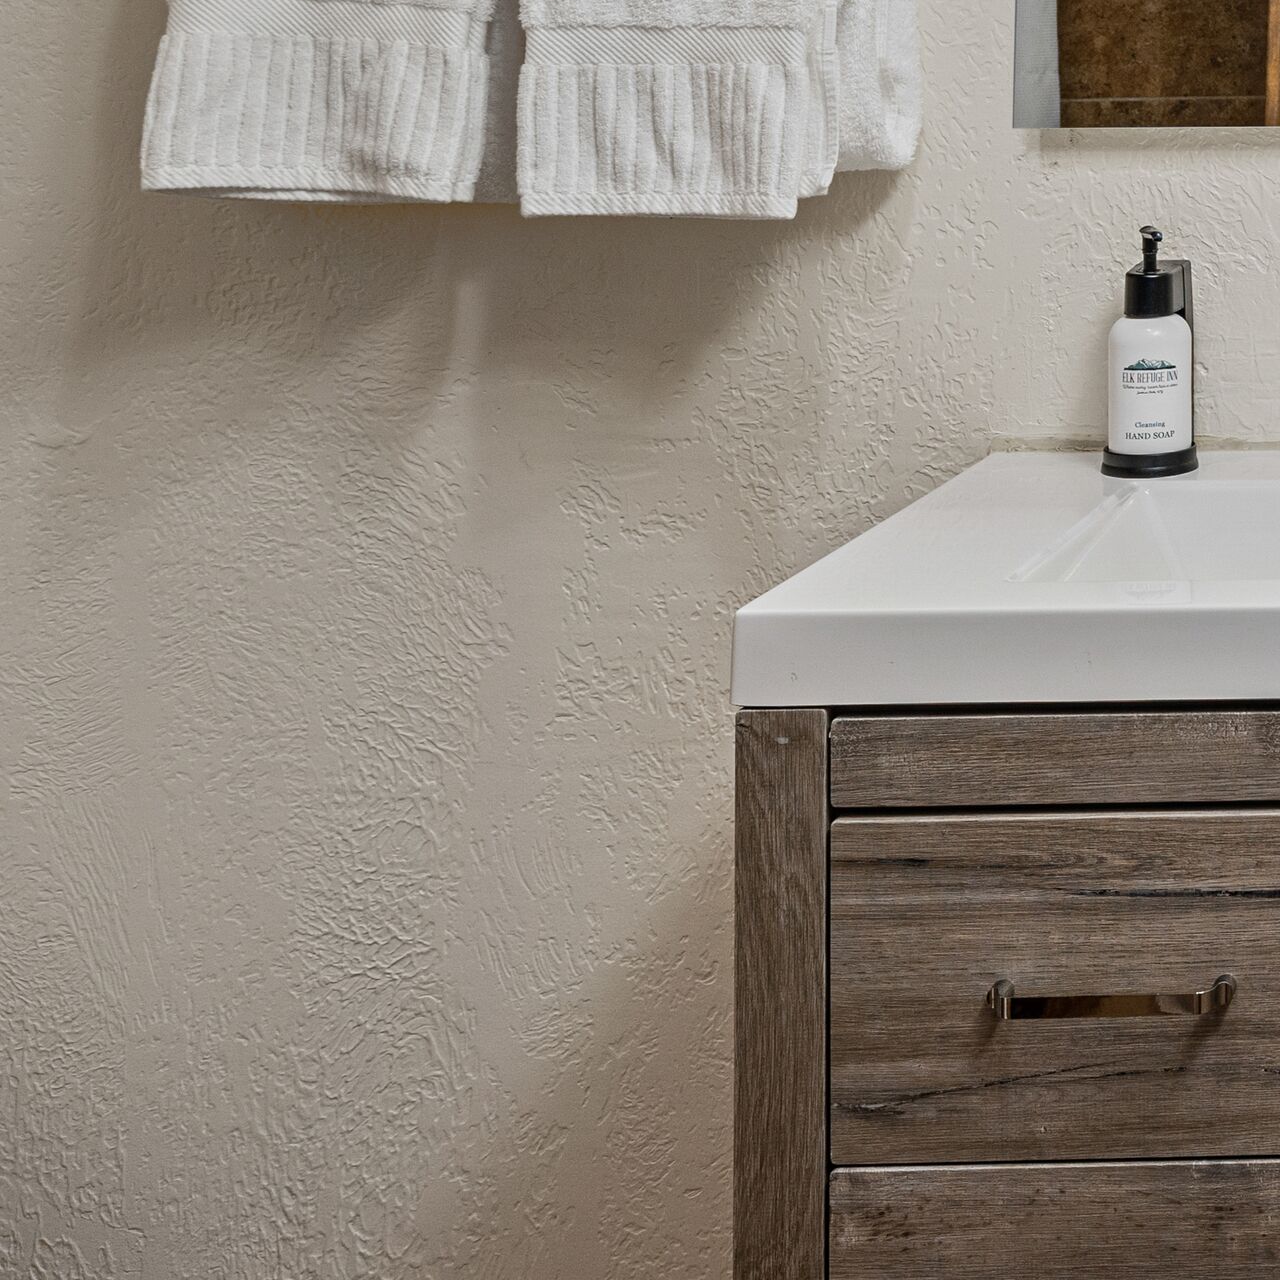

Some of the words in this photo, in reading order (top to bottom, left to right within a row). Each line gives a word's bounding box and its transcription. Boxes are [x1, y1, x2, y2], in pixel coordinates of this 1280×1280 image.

[1122, 372, 1135, 383] ELK
[1137, 371, 1165, 383] REFUGE
[1166, 370, 1178, 381] INN
[1125, 432, 1152, 440] HAND
[1153, 430, 1175, 439] SOAP
